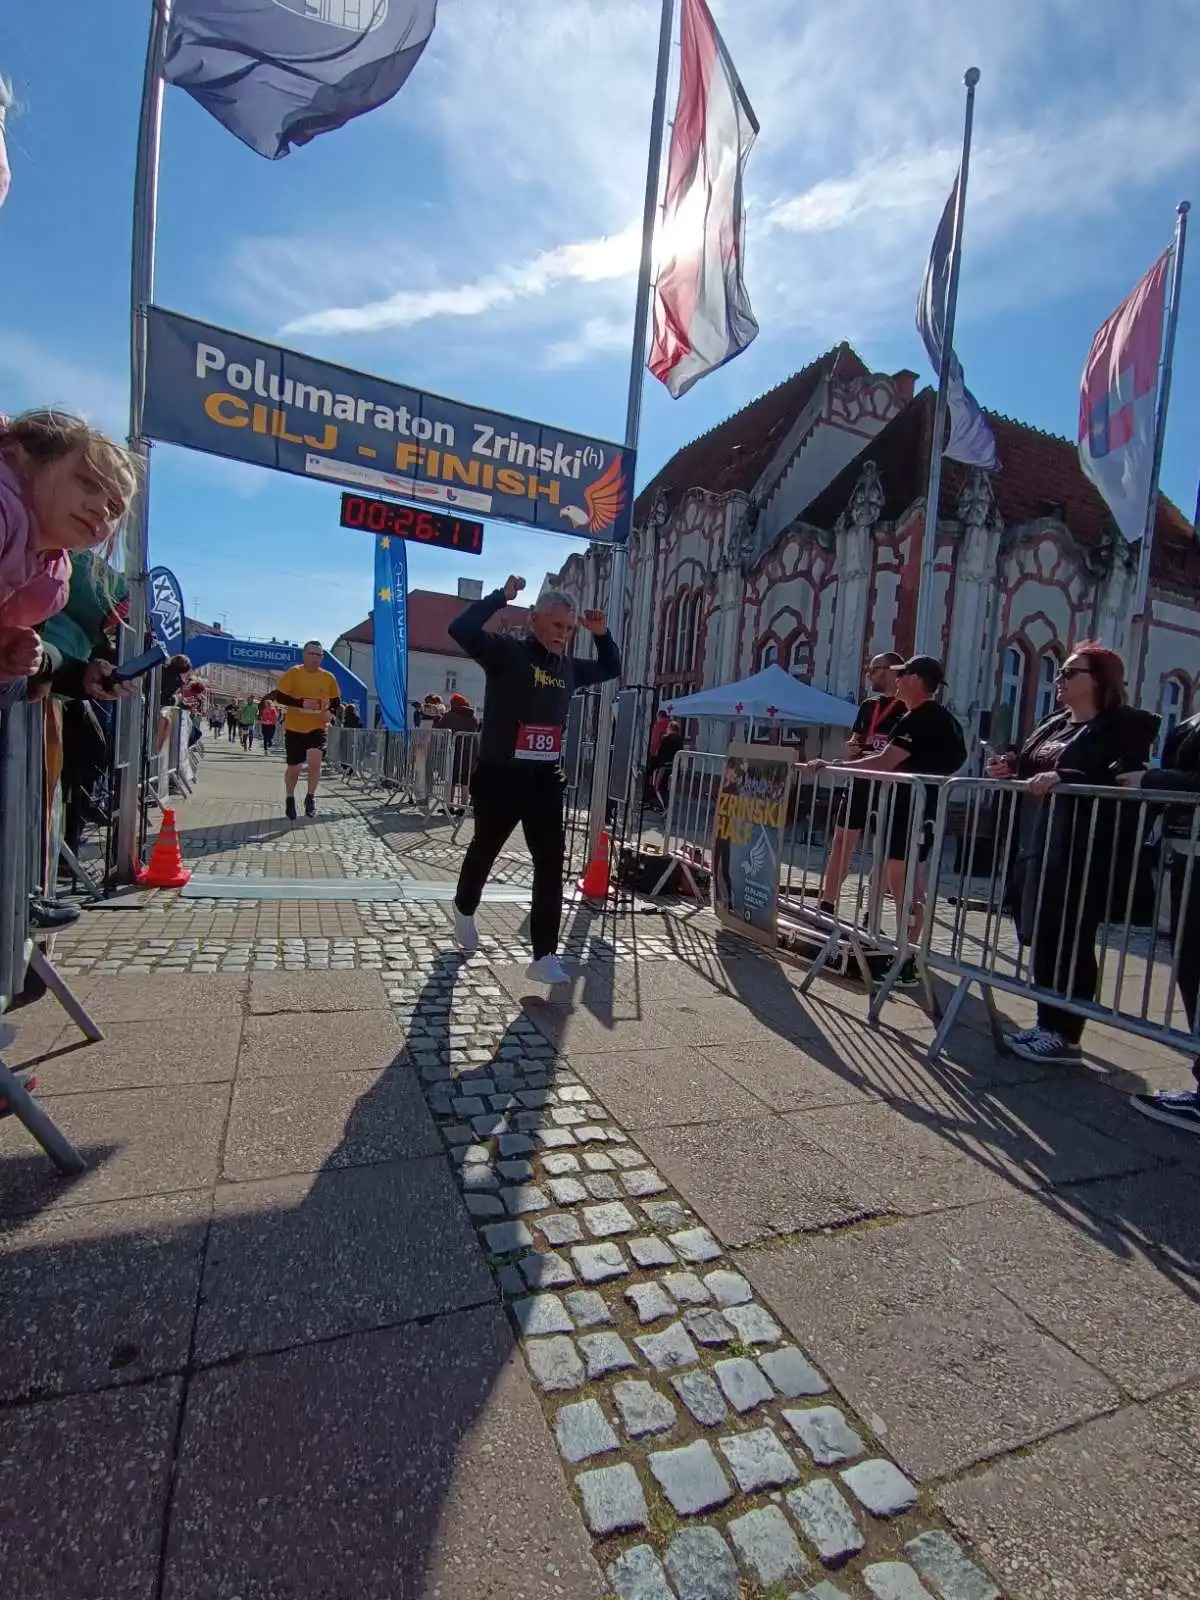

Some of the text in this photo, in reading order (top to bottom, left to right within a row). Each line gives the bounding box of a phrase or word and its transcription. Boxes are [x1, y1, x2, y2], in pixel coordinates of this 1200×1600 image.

[196, 342, 455, 446] Polumaraton
[204, 392, 338, 450] CILJ
[395, 442, 561, 505] FINISH
[344, 498, 480, 547] 00:26:11
[232, 647, 291, 661] DECATHLON
[525, 733, 555, 751] 189
[719, 792, 785, 829] ZRINSKI
[715, 816, 752, 847] HALF
